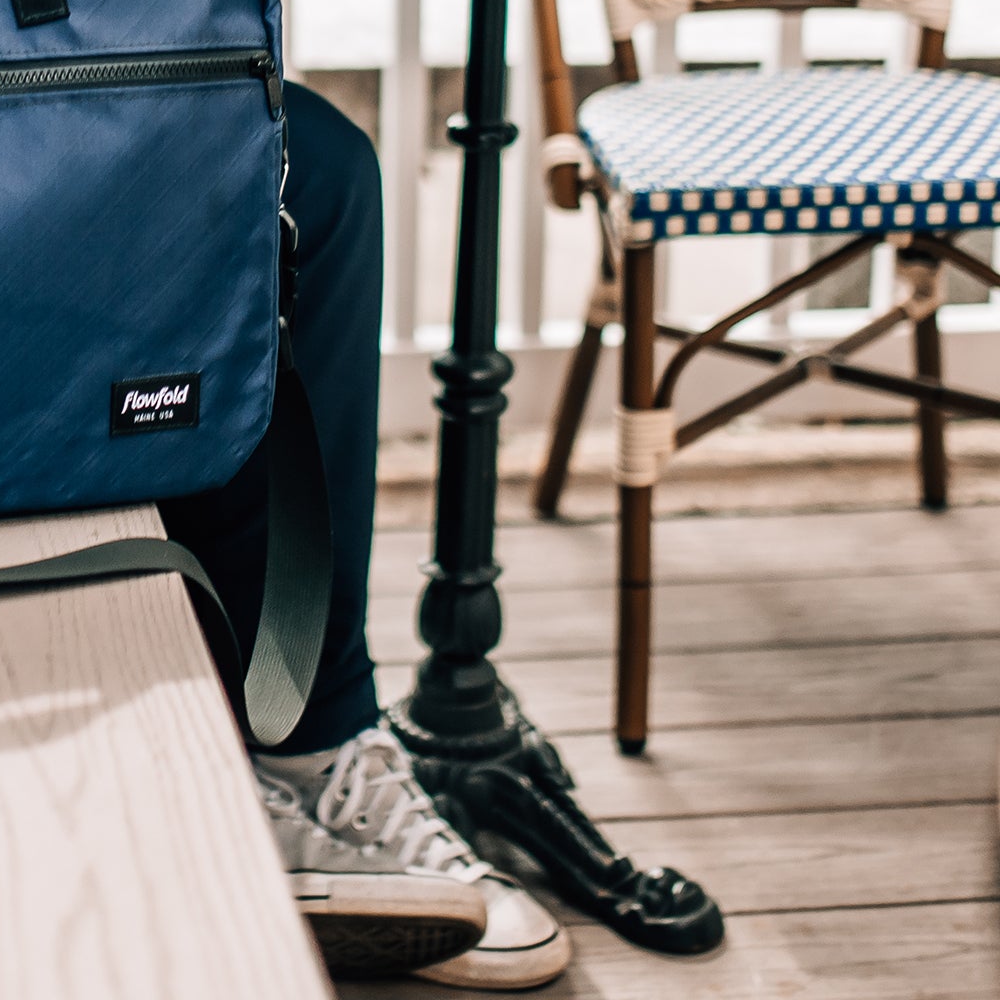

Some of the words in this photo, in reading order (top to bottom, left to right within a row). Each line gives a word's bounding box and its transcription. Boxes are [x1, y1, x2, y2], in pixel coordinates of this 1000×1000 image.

[121, 384, 190, 415] flowfold
[133, 411, 156, 424] MAINE
[159, 409, 174, 420] USA
